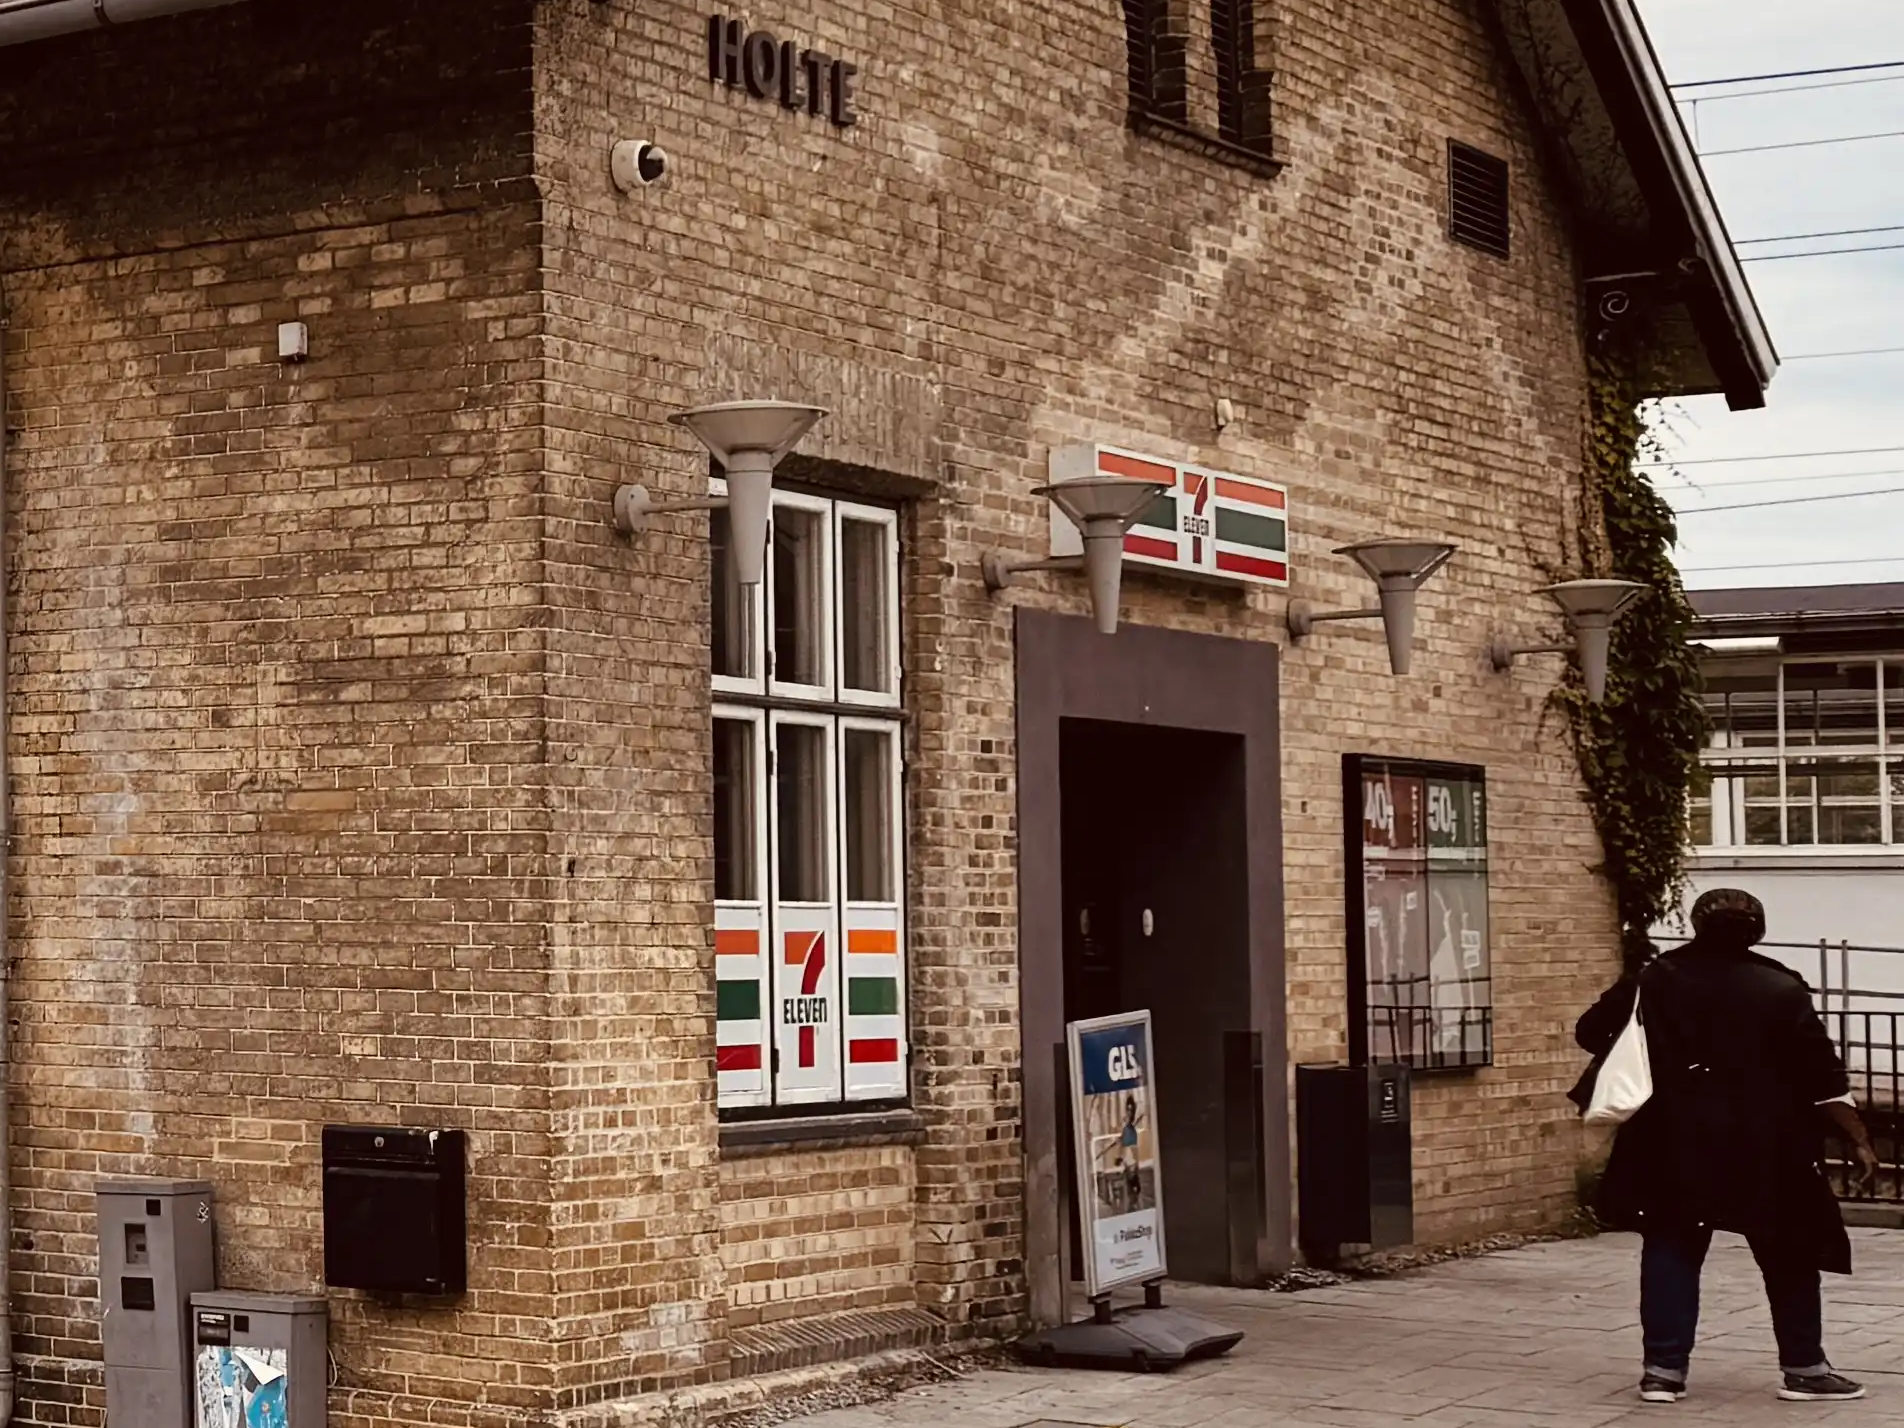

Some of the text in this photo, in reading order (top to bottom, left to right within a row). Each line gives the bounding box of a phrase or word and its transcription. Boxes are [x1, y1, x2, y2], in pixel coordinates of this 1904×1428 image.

[709, 15, 857, 128] HOLTE
[784, 931, 825, 1068] 7
[1108, 1044, 1142, 1082] GLS
